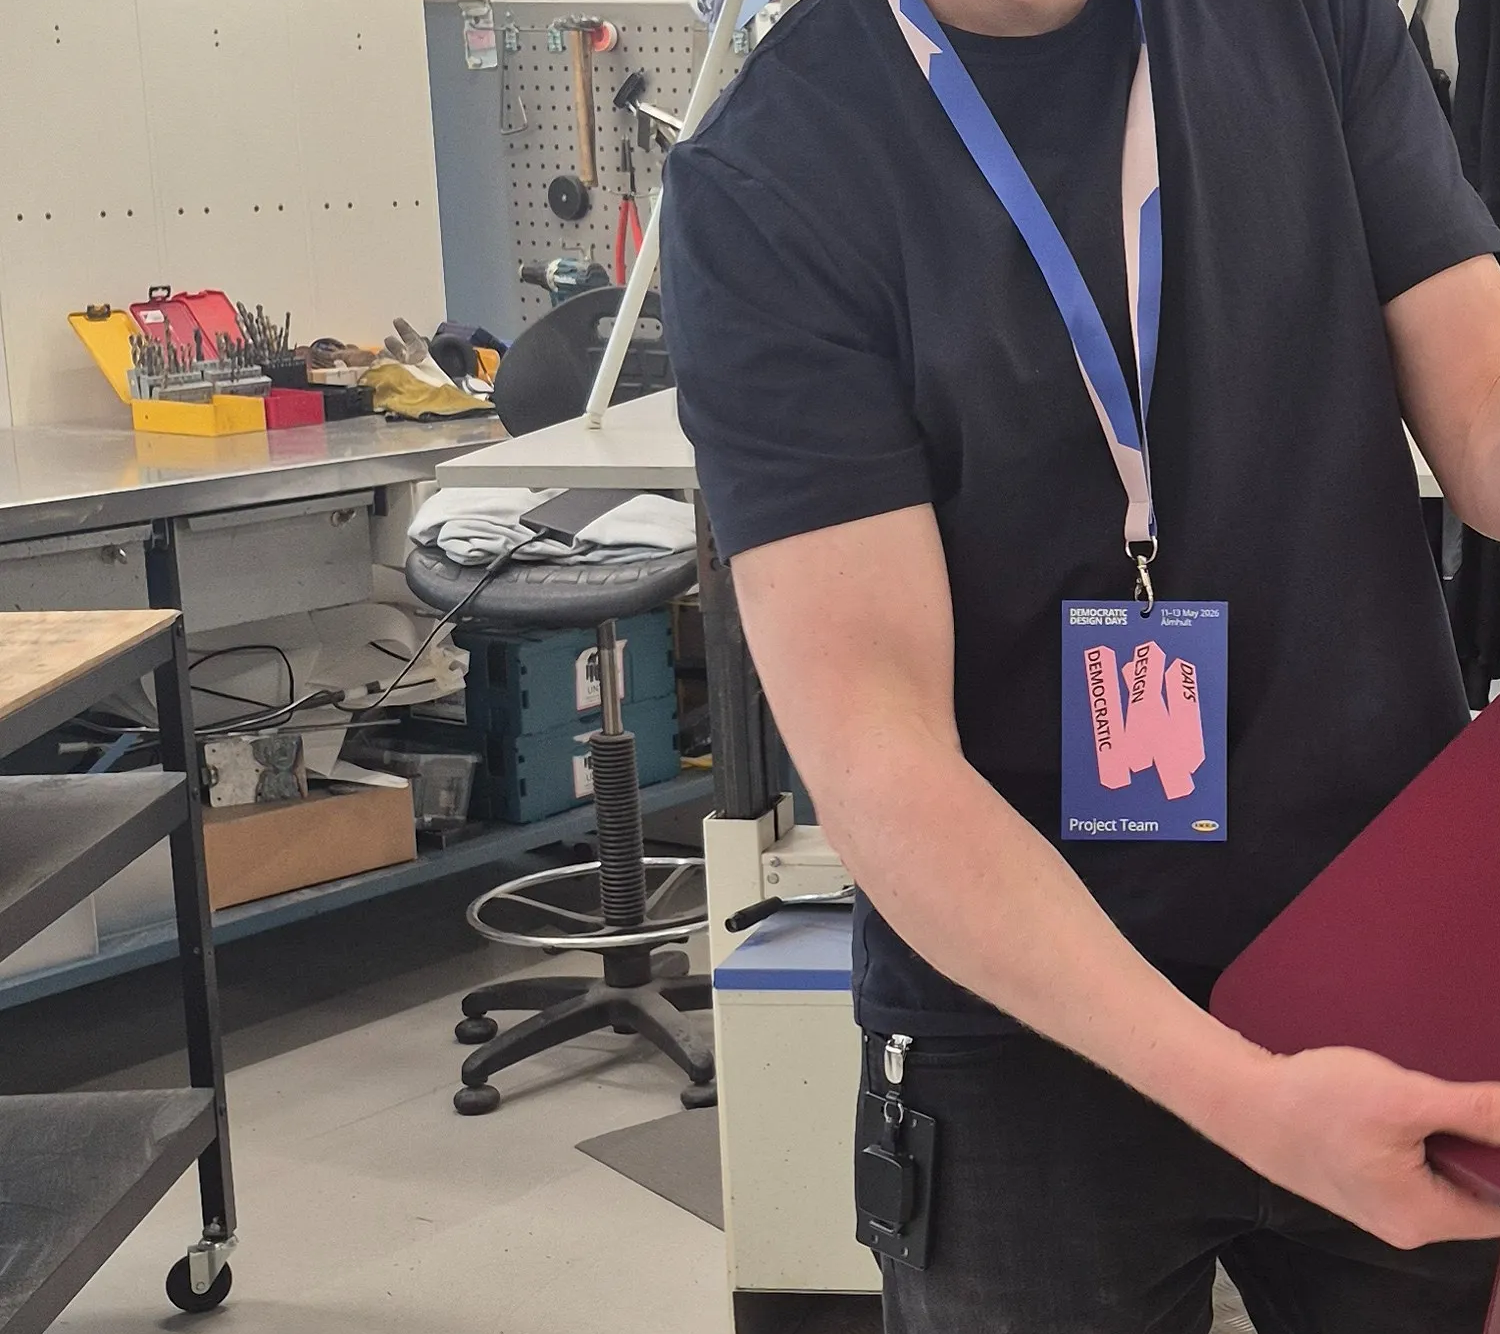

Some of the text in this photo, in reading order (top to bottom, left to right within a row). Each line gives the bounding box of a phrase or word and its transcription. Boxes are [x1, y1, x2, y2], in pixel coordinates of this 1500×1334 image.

[1070, 608, 1128, 616] DEMOCRATIC
[1182, 608, 1199, 619] May
[1070, 617, 1128, 625] DESIGN DAYS
[1131, 646, 1150, 704] DESIGN
[1180, 662, 1196, 703] DAYS
[1087, 650, 1112, 752] DEMOCRATIC
[1069, 818, 1159, 835] Project Team
